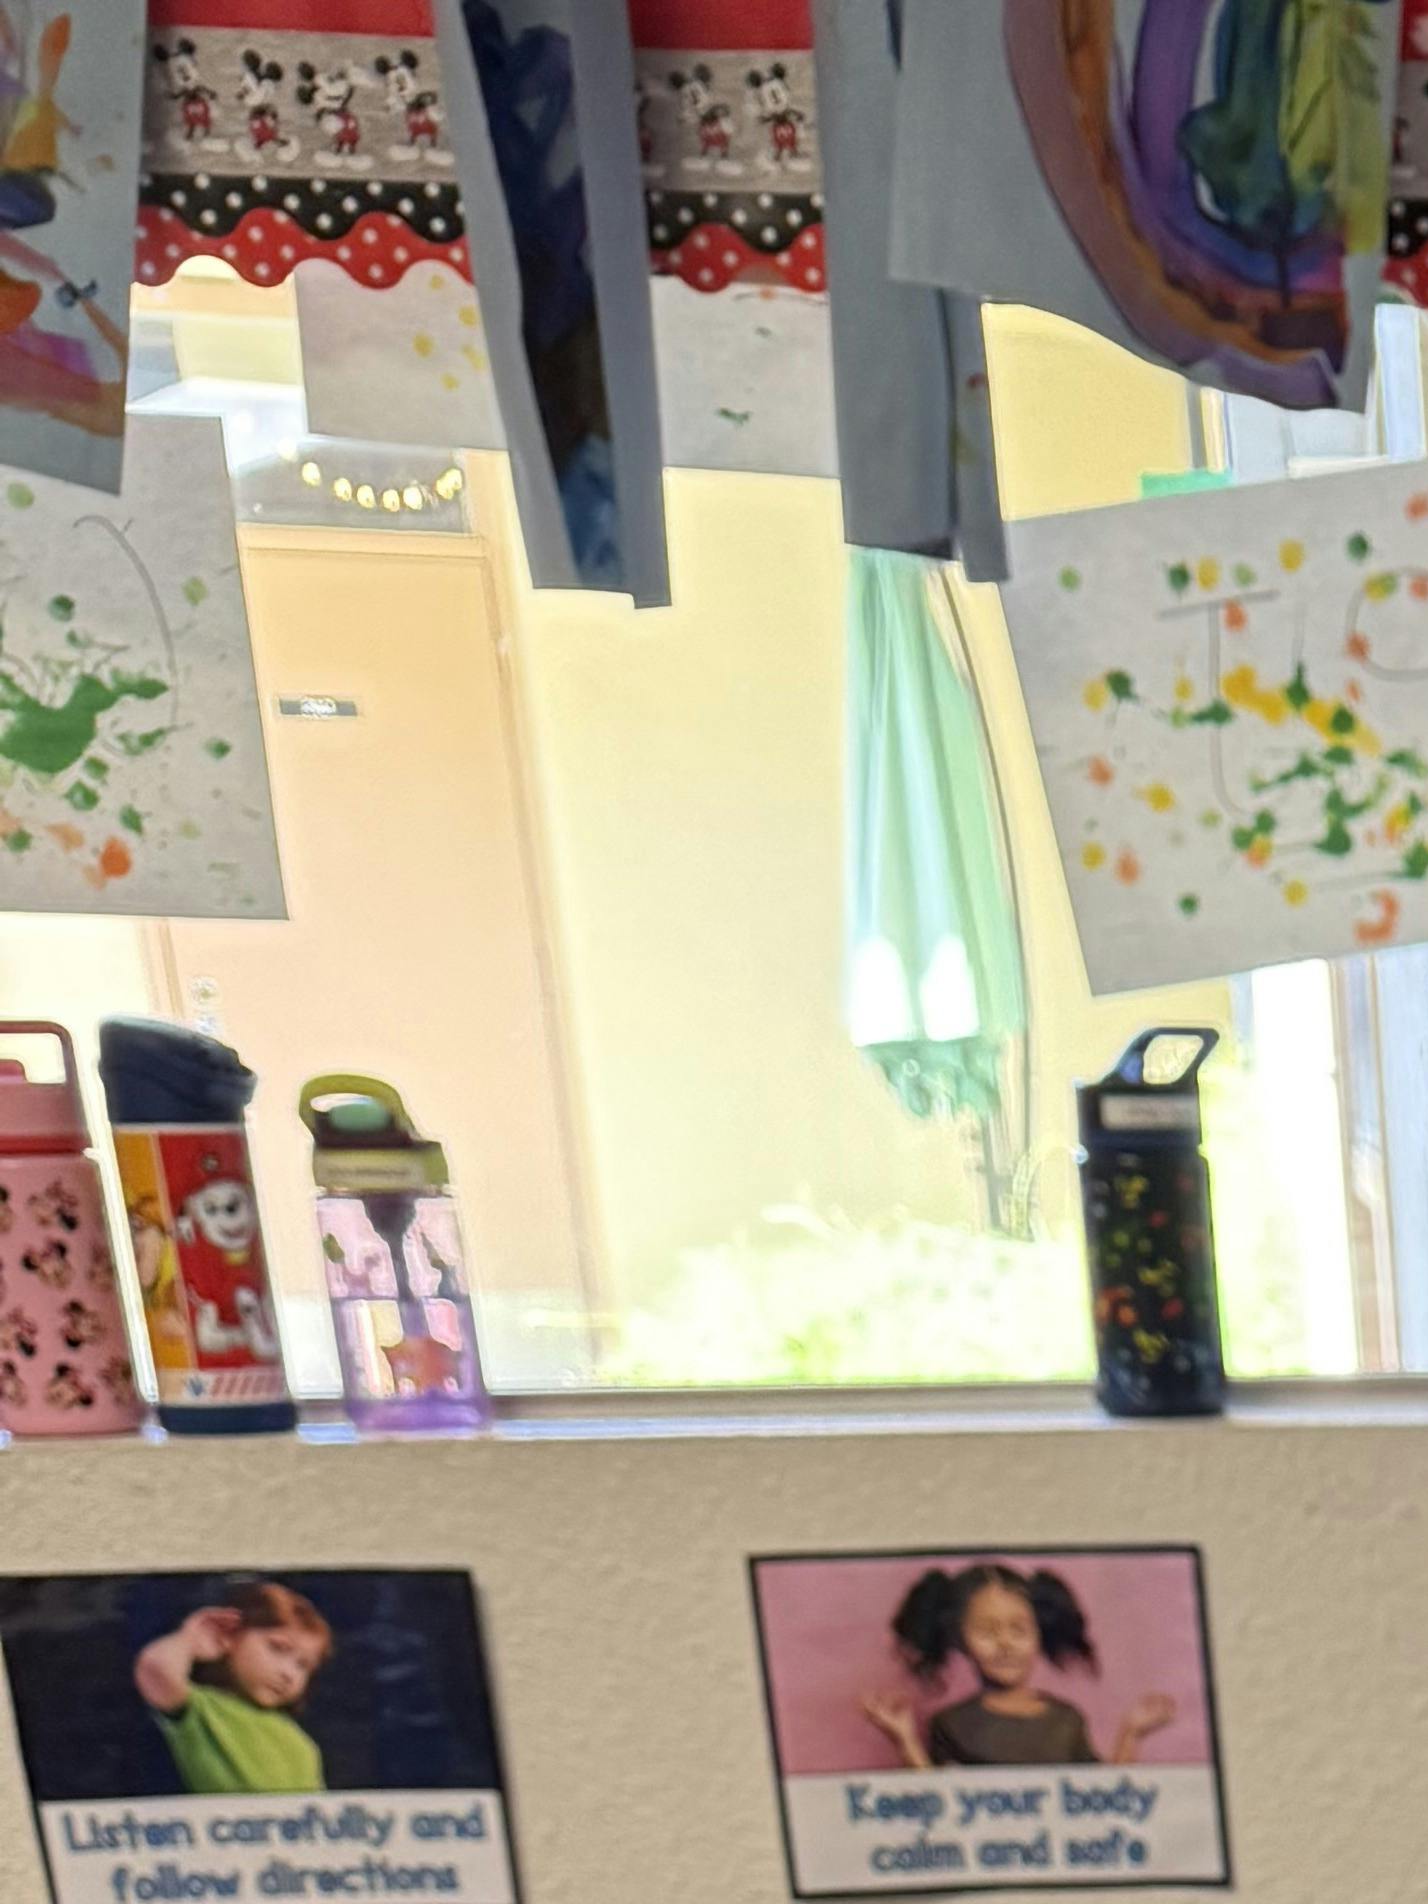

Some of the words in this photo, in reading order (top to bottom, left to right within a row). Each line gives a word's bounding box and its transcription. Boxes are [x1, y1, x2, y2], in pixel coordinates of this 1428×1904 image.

[63, 1812, 193, 1852] Listen
[208, 1802, 394, 1848] carefully
[411, 1800, 486, 1840] and
[845, 1782, 947, 1827] Keep
[954, 1785, 1050, 1827] your
[1059, 1777, 1158, 1821] body
[869, 1835, 965, 1874] calm
[976, 1830, 1052, 1868] and
[1066, 1827, 1148, 1866] safe
[258, 1855, 457, 1898] directions
